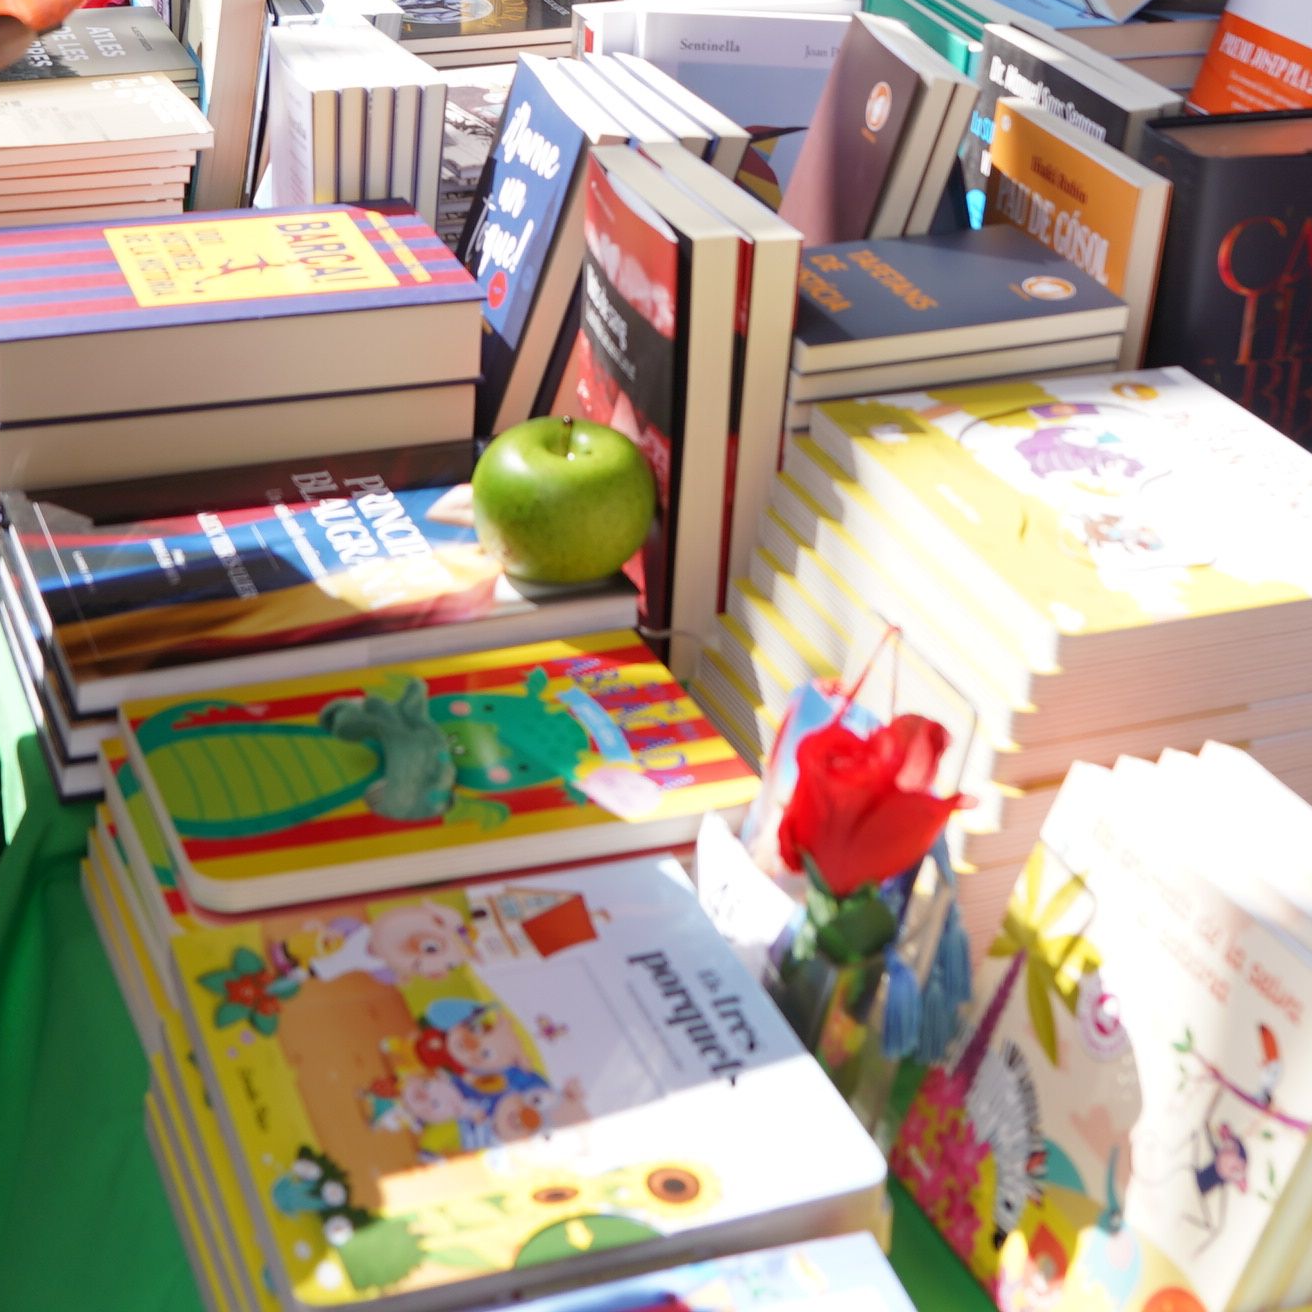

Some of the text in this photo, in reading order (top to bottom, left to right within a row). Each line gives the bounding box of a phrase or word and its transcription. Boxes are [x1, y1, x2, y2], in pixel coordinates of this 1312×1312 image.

[85, 25, 127, 60] ATLES
[679, 36, 830, 59] Sentinella Joan
[499, 177, 527, 219] un
[275, 220, 370, 284] BARÇA!
[1027, 189, 1057, 245] DE
[1053, 209, 1111, 287] GÓSOL
